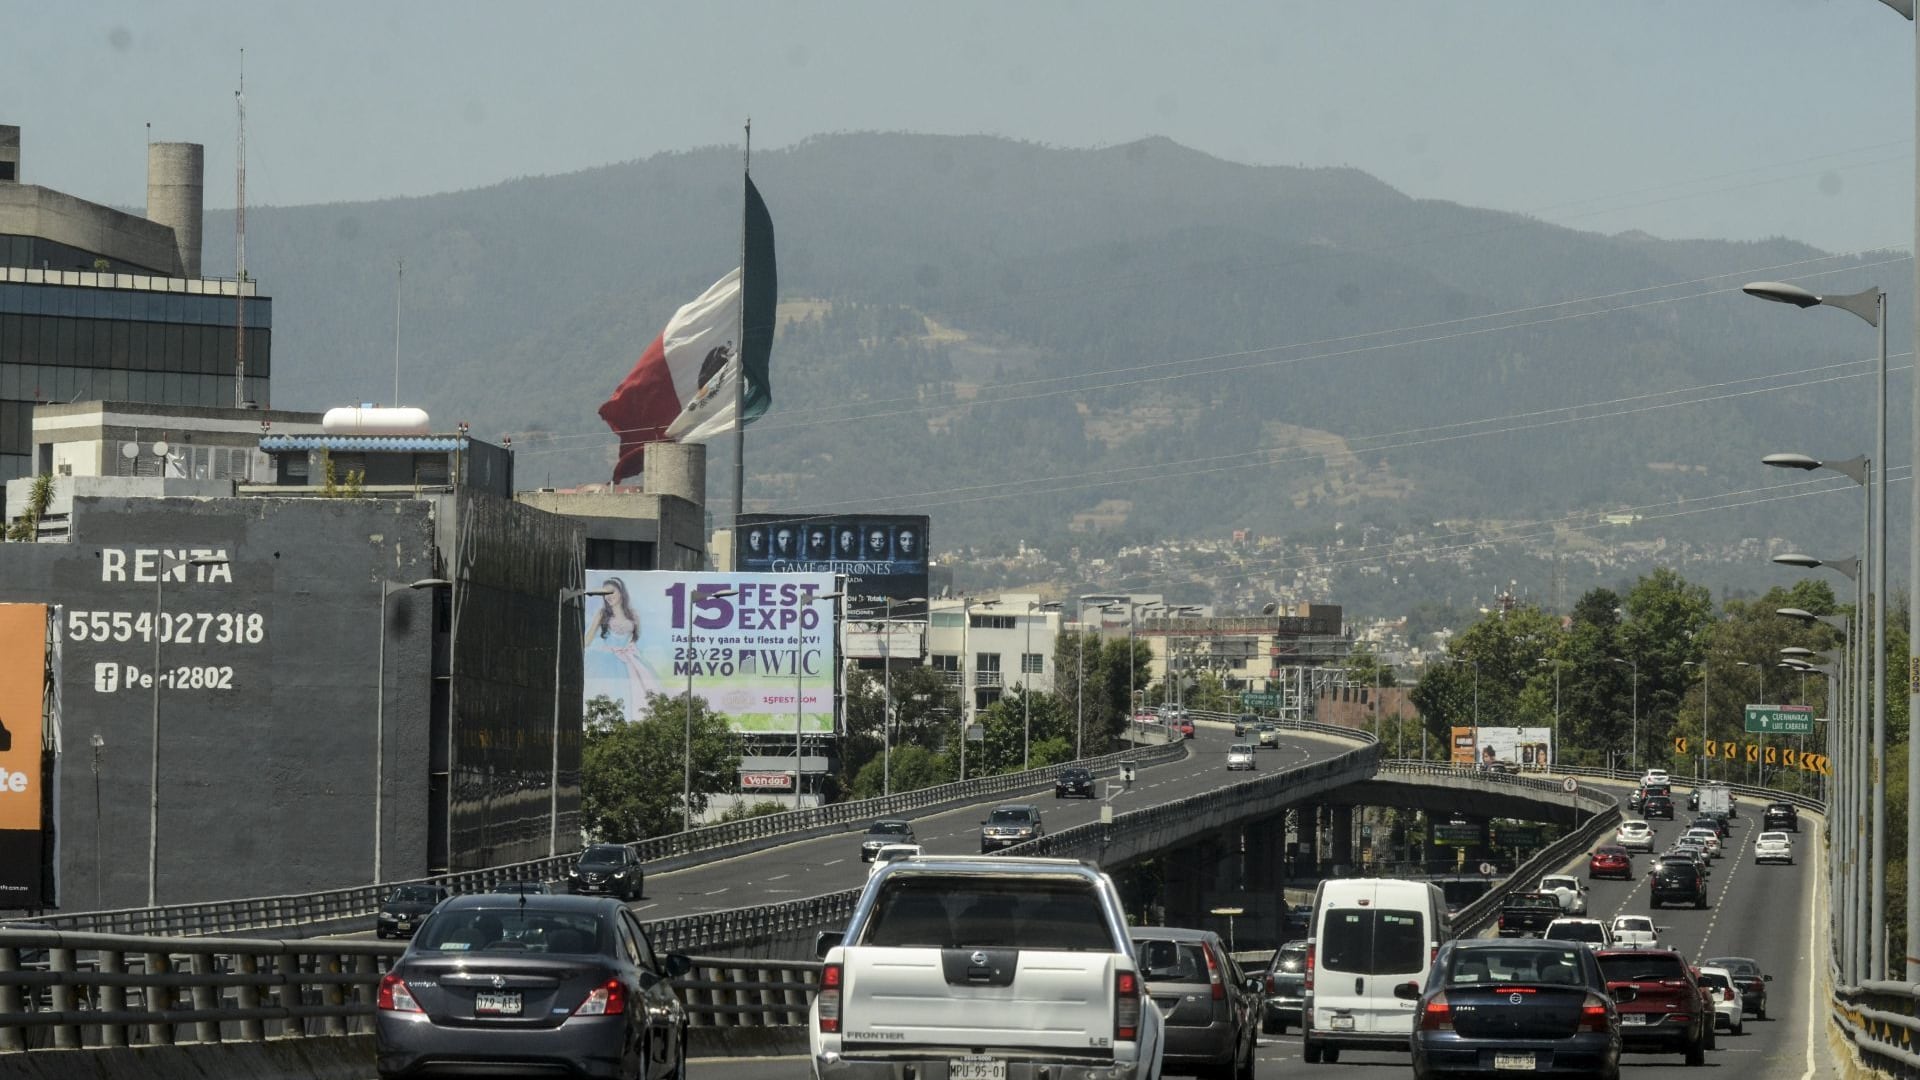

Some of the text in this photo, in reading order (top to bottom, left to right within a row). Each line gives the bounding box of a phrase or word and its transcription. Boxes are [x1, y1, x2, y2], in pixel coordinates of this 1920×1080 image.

[102, 548, 233, 583] RENTA
[771, 560, 818, 573] GAME
[826, 560, 893, 575] THRONES
[665, 583, 819, 630] 15 FEST
[69, 611, 264, 644] 5554027318
[739, 608, 819, 630] EXPO
[672, 635, 705, 644] ¡Asste
[709, 637, 715, 645] y
[718, 637, 740, 645] gana
[744, 635, 754, 644] tu
[757, 635, 784, 645] fiesta
[787, 635, 798, 644] de
[674, 662, 734, 676] MAYO
[760, 649, 821, 675] WTC
[126, 665, 233, 690] Peri2802
[846, 1031, 905, 1040] FRONTIER
[1089, 1036, 1109, 1046] LE
[950, 1064, 1005, 1077] MPU-95-01
